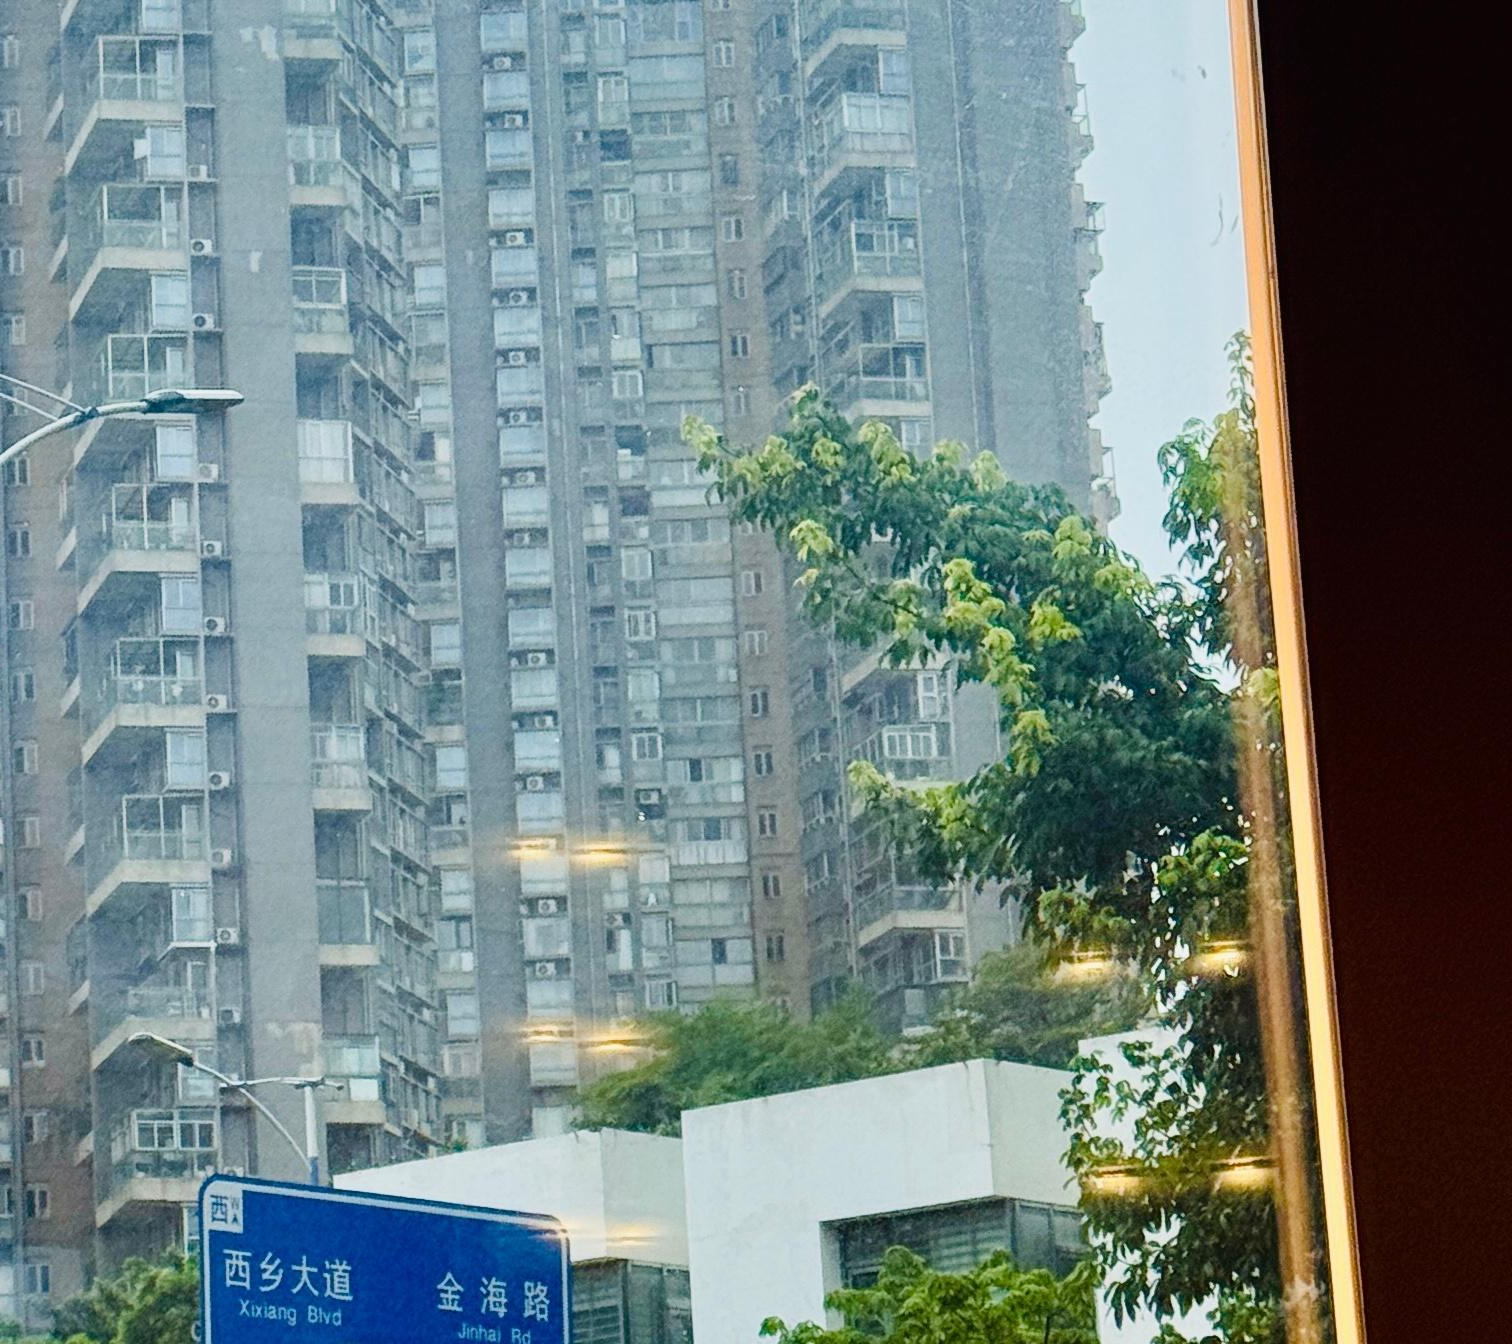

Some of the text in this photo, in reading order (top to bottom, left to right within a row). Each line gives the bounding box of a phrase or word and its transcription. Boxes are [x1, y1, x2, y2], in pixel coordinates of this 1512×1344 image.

[210, 1194, 228, 1224] 西
[223, 1249, 354, 1302] 西乡大道
[436, 1272, 551, 1322] 金海路
[239, 1299, 343, 1327] Xixiang Blvd
[458, 1323, 502, 1344] Jinhai
